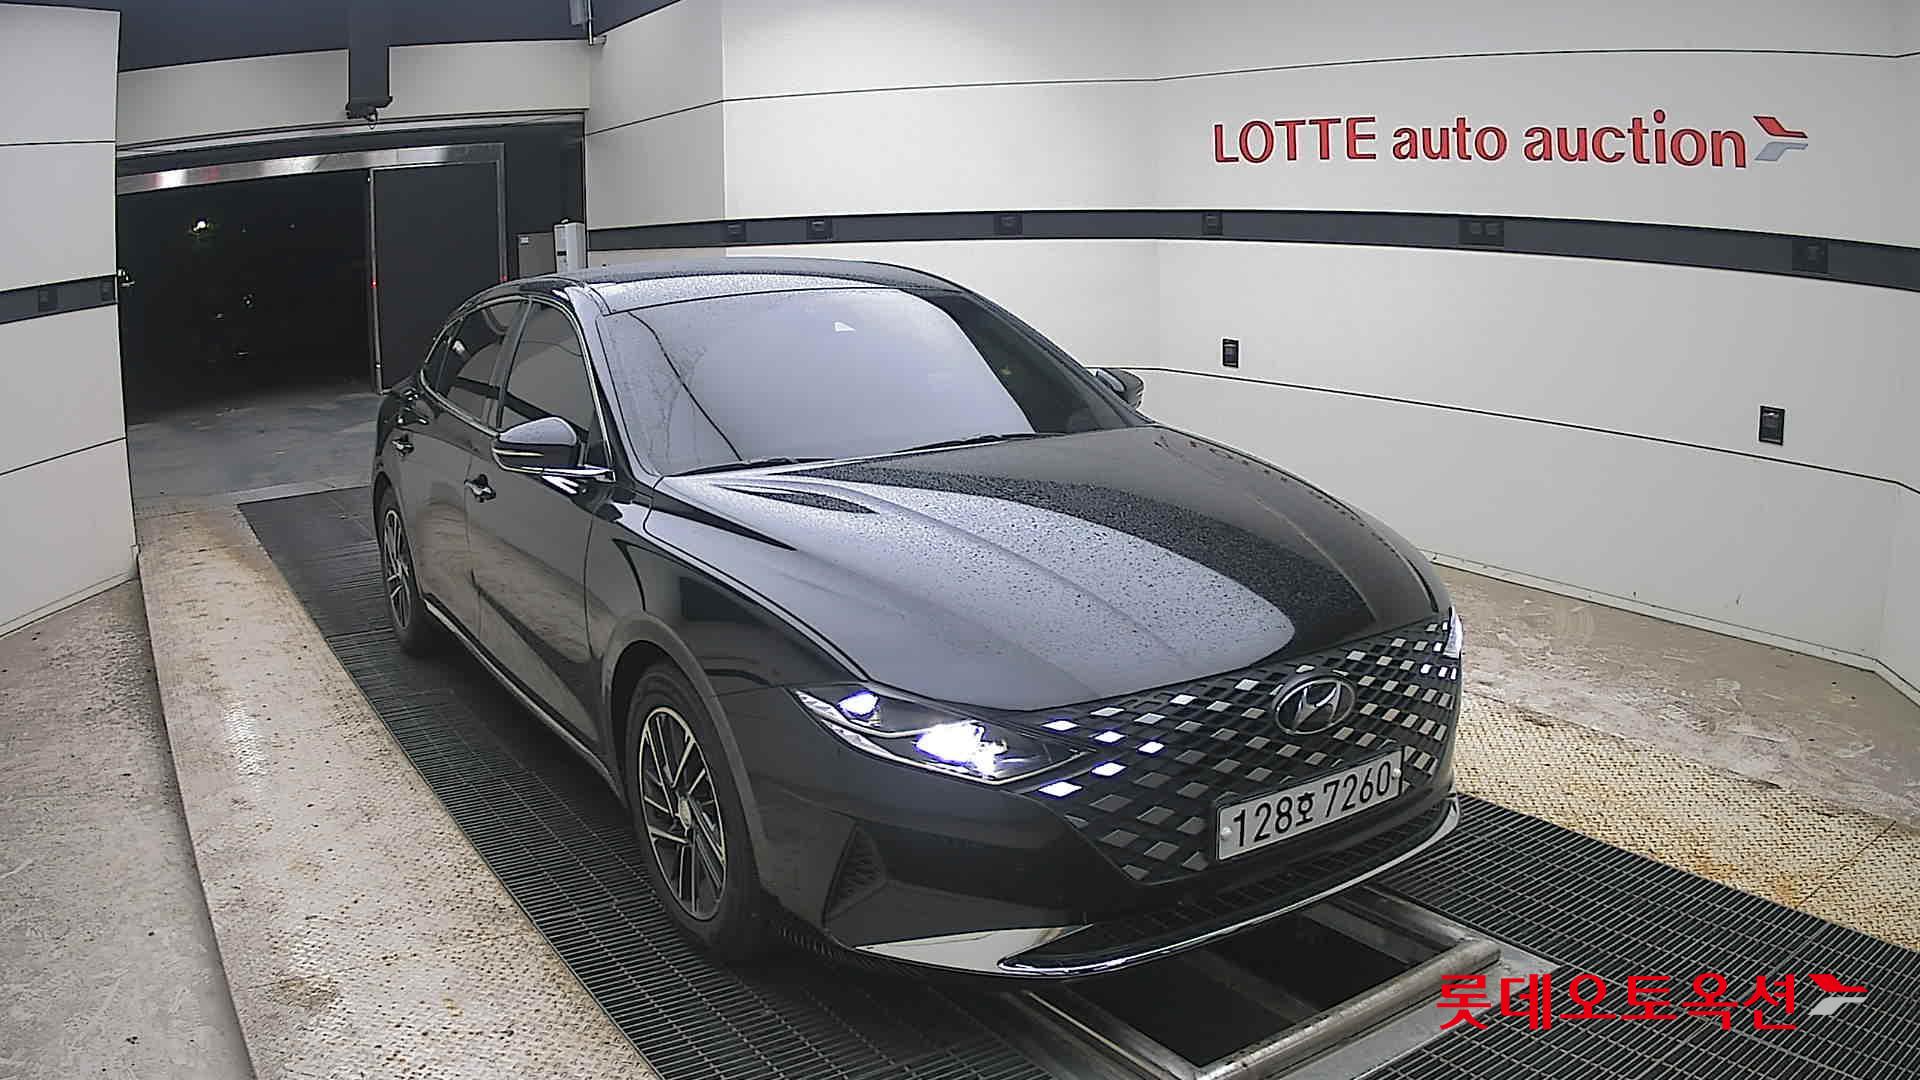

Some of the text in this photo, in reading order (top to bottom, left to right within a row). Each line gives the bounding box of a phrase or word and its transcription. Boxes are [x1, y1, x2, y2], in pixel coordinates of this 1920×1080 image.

[1213, 109, 1746, 168] LOTTE auto auction
[1233, 761, 1392, 847] 128호 7260
